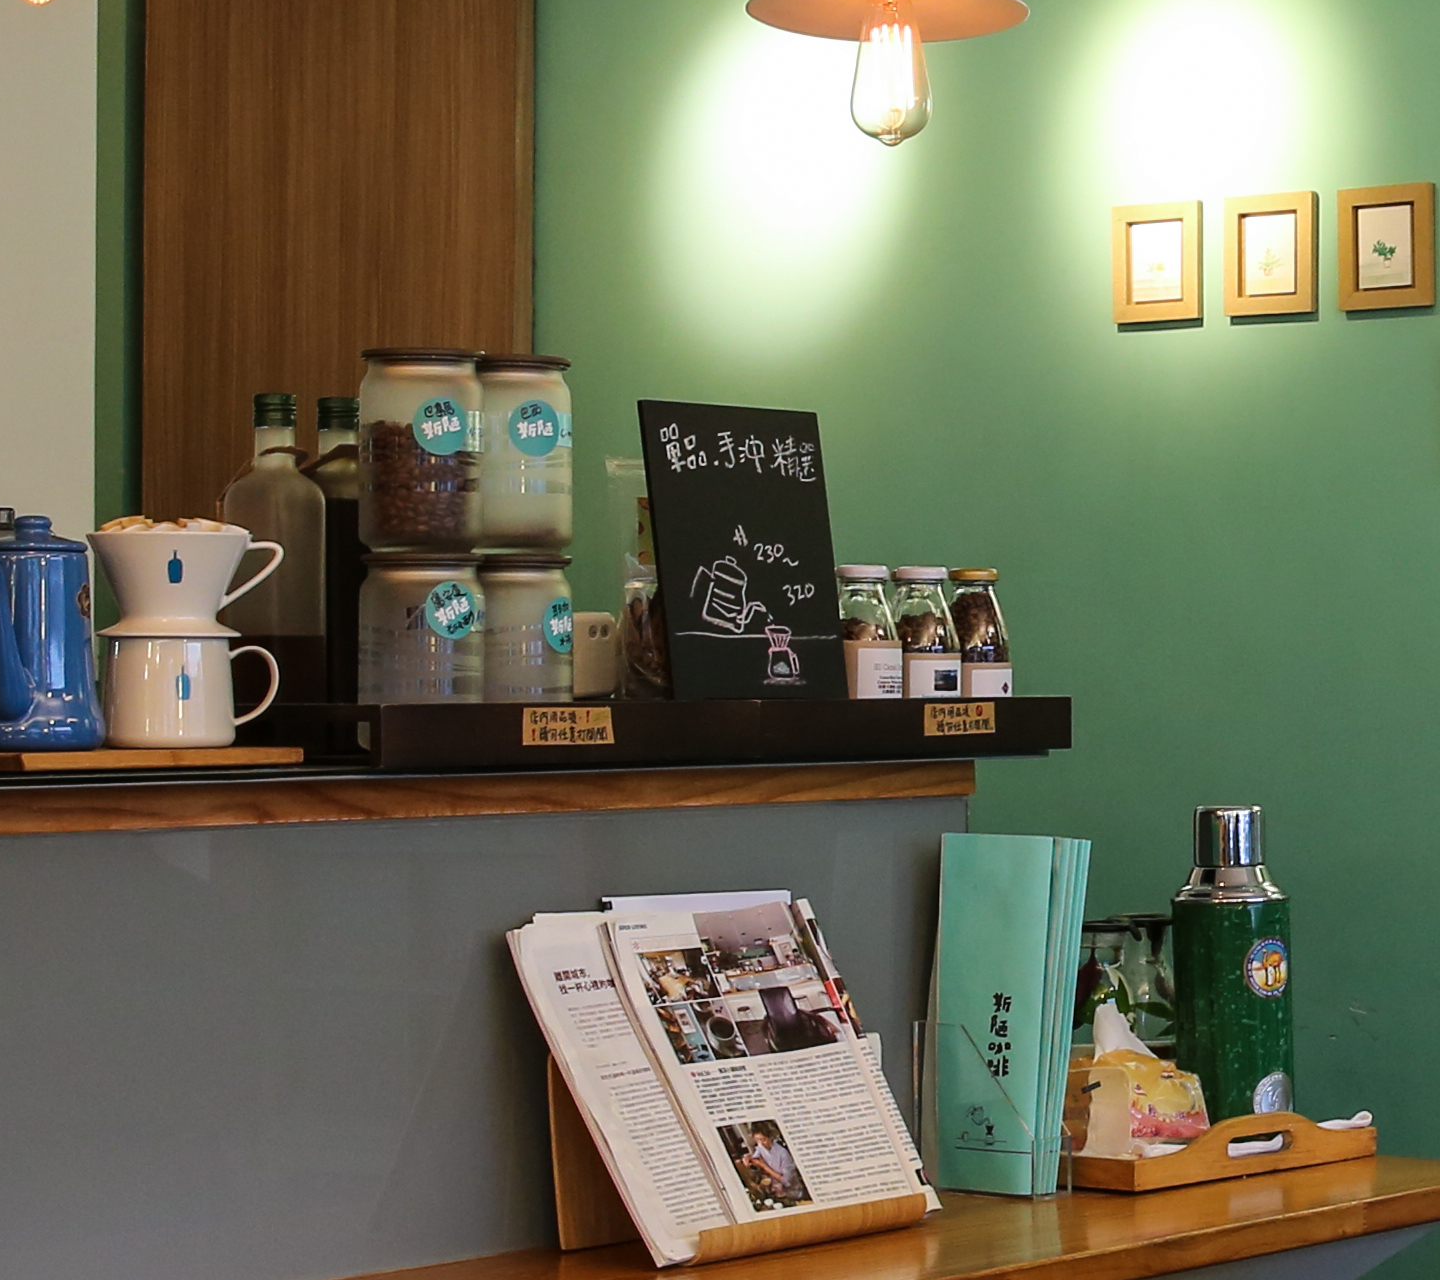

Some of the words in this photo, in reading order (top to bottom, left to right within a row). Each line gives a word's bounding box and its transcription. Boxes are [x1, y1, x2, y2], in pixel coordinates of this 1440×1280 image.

[421, 416, 461, 440] 斯陋
[517, 420, 554, 439] 斯陋
[782, 583, 815, 606] 320
[987, 992, 1012, 1078] 斯陋咖啡
